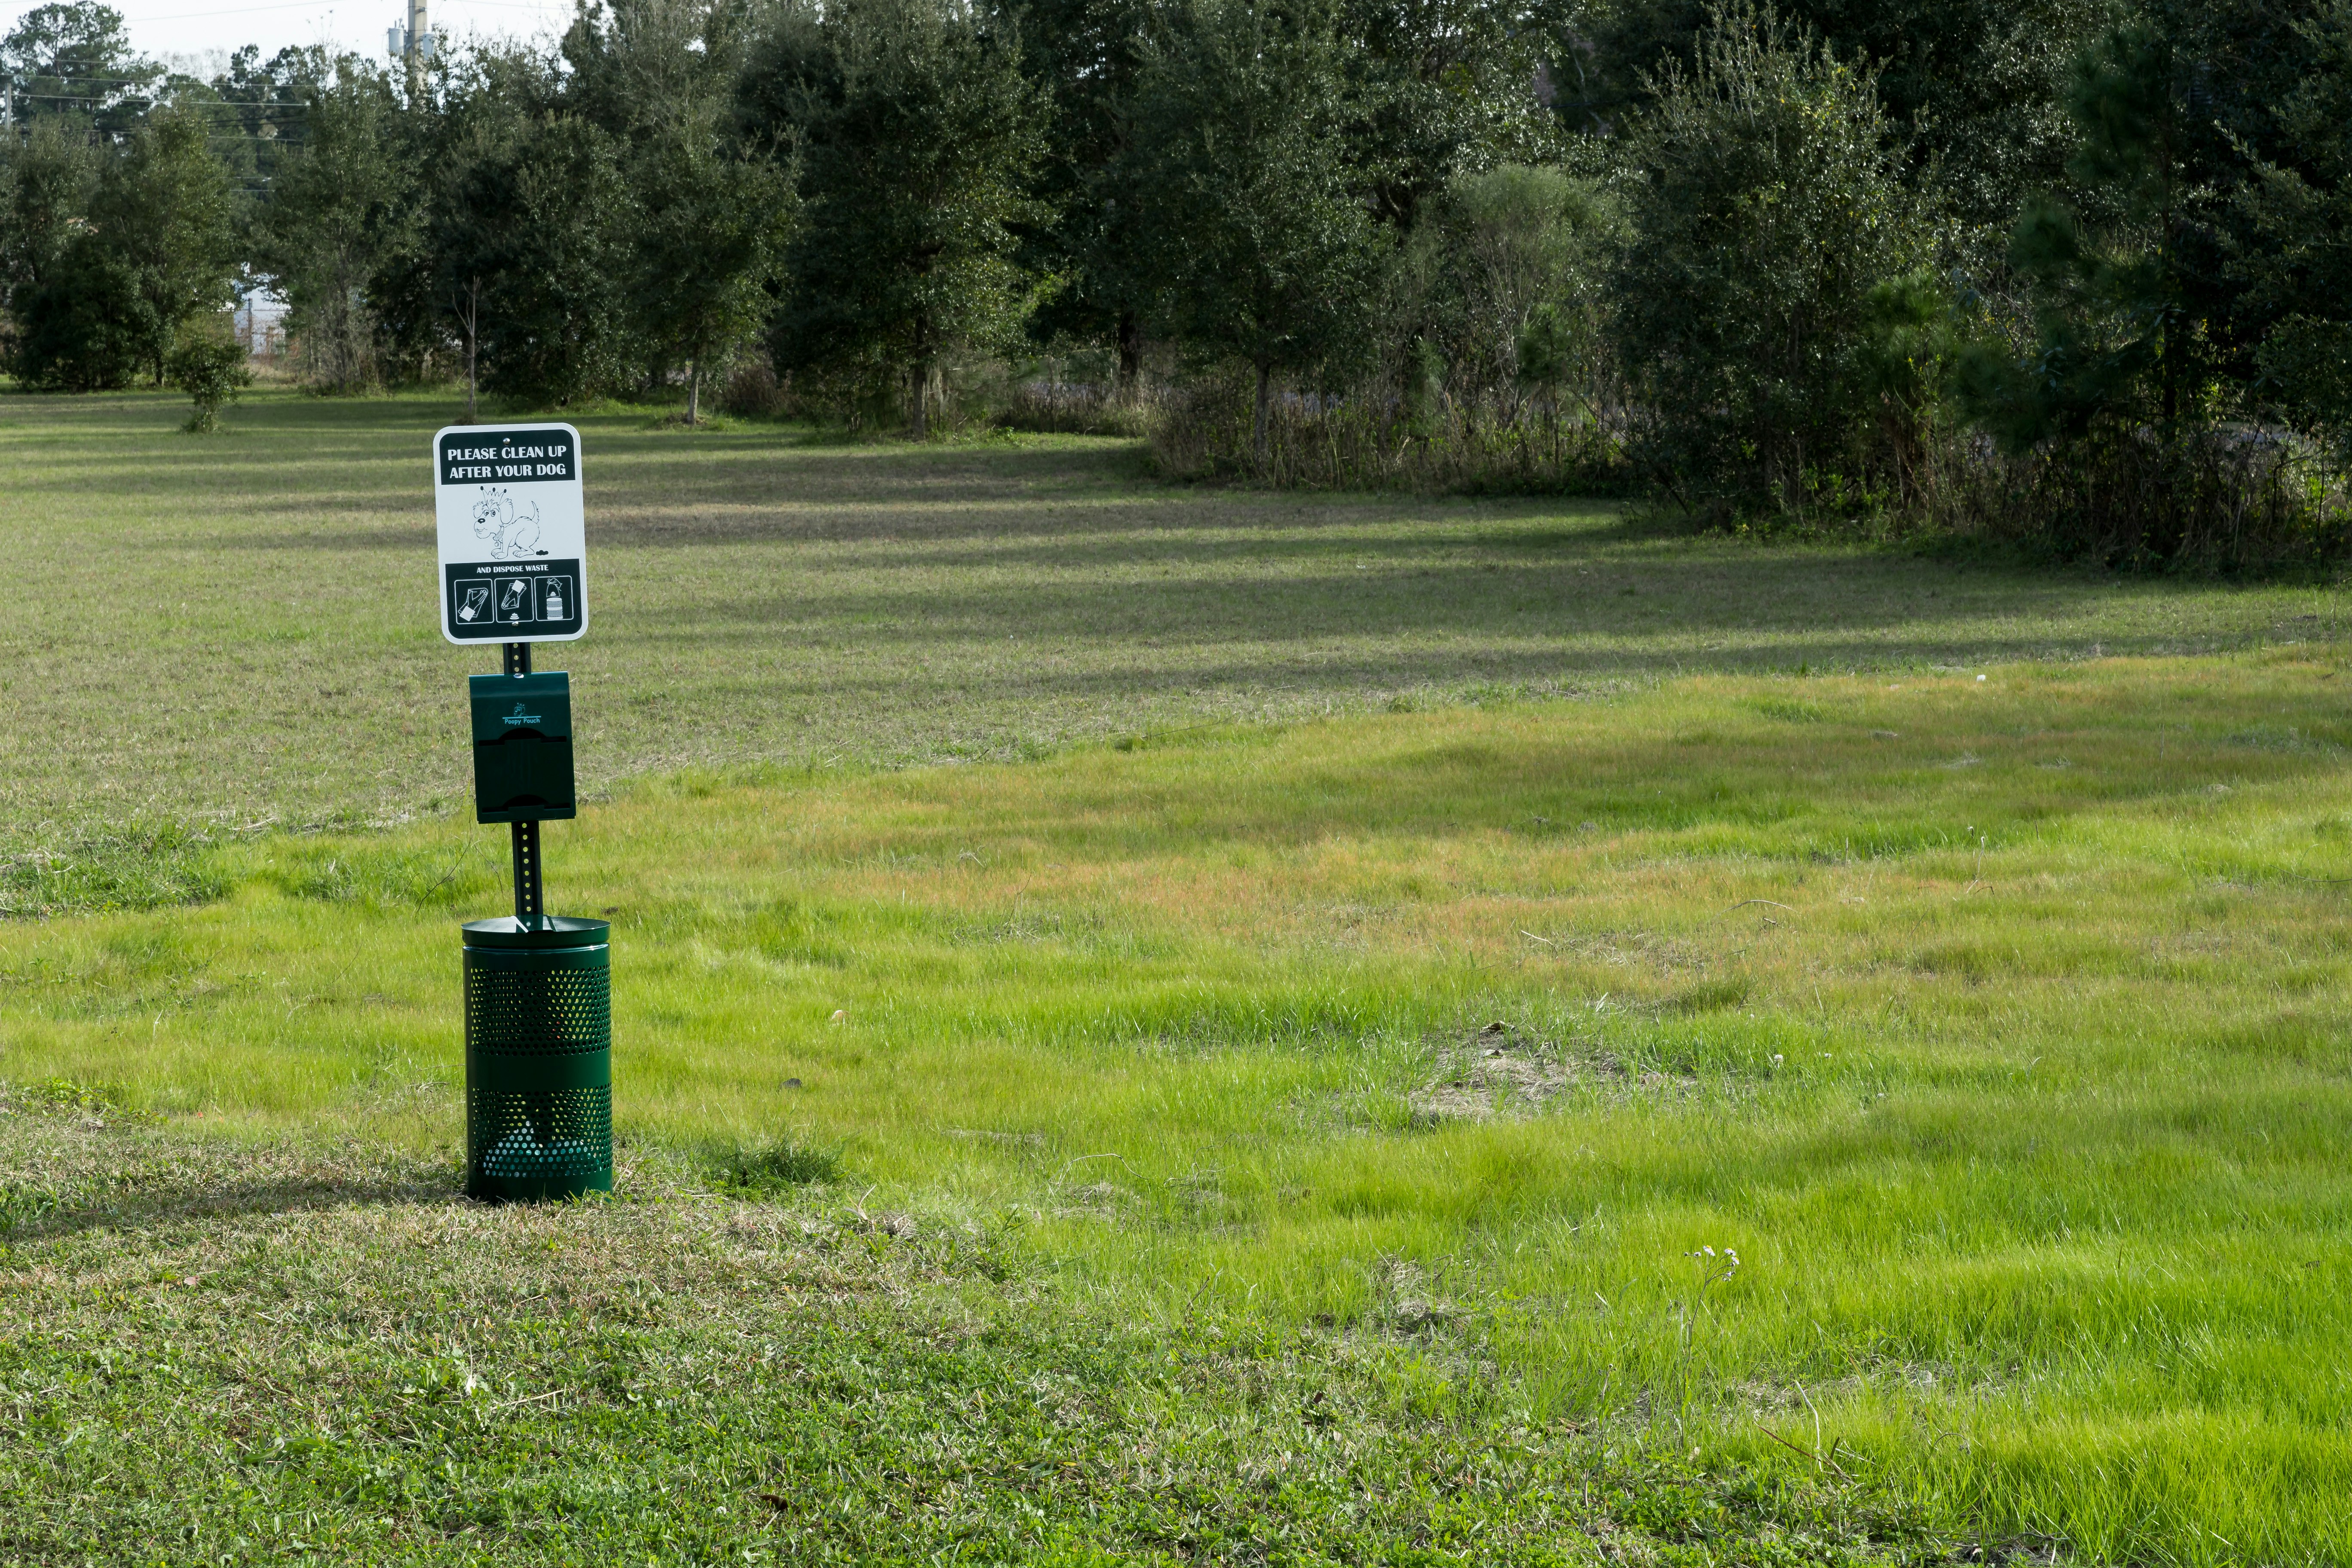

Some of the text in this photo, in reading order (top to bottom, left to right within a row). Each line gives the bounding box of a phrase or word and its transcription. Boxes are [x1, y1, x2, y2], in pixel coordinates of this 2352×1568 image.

[448, 446, 567, 460] PLEASE CLEAN UP
[450, 463, 566, 478] AFTER YOUR DOG
